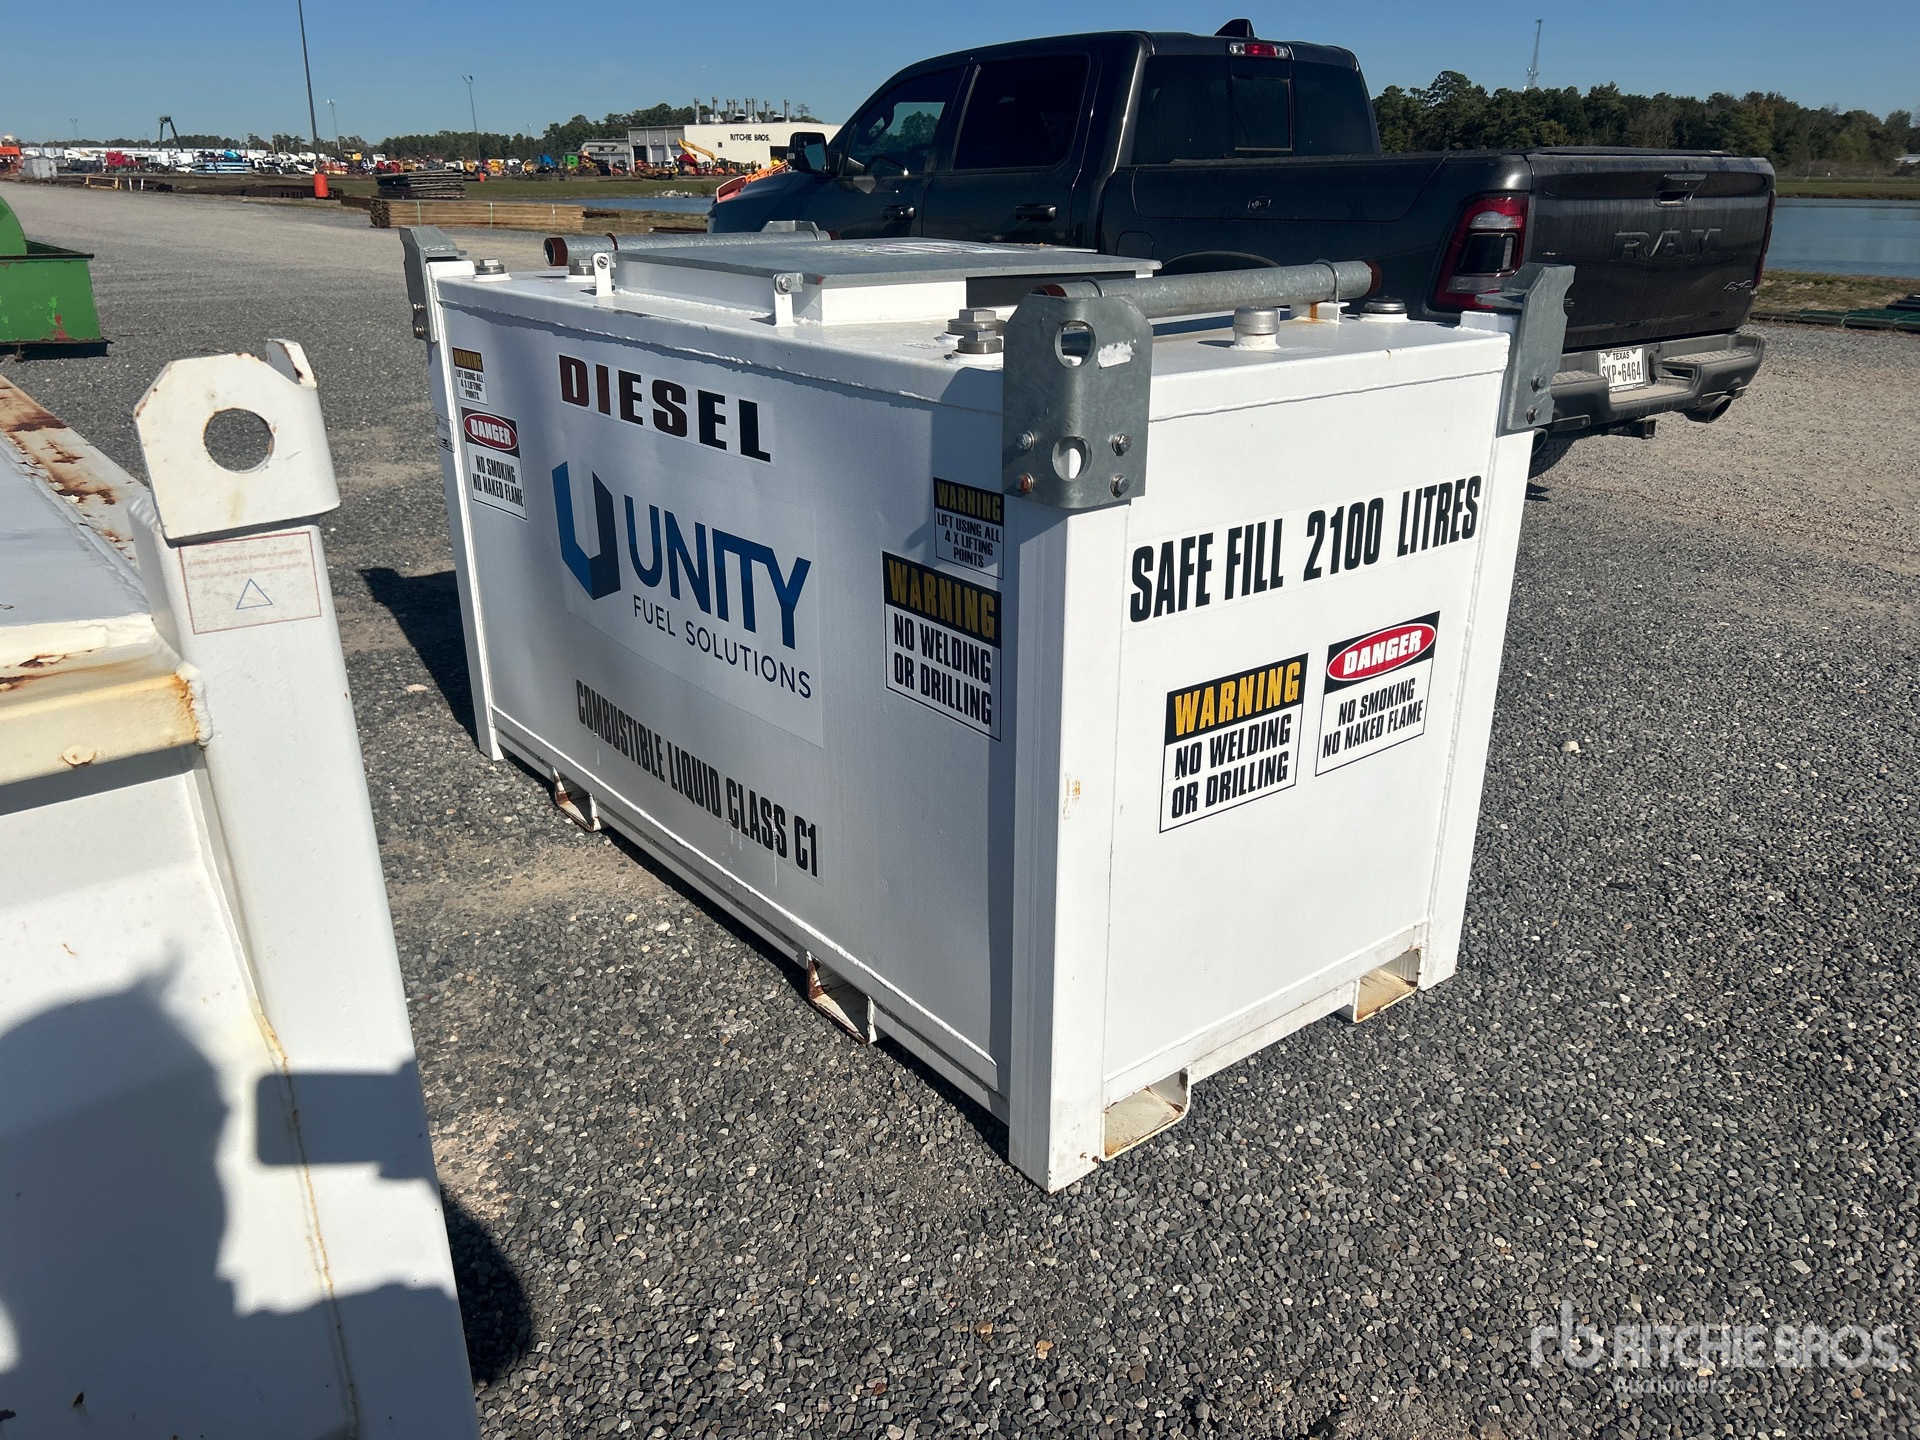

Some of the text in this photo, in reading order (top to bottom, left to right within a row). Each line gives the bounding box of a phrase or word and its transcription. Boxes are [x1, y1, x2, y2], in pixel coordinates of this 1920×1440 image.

[730, 133, 752, 141] RITCHIE
[1609, 228, 1722, 262] RAM
[454, 349, 482, 370] WARNING
[1612, 351, 1630, 361] TEXAS
[465, 389, 480, 400] POINTS
[468, 381, 482, 392] LIFTING
[476, 373, 484, 383] ALL
[559, 354, 771, 462] DIESEL
[470, 418, 512, 446] DANGER
[472, 473, 524, 507] NO NAKED FLAME
[475, 455, 516, 484] NO SMOKING
[936, 482, 1001, 522] WARNING
[937, 512, 1001, 543] LIFT USING ALL
[944, 530, 993, 556] 4 X LIFTING
[1129, 475, 1482, 623] SAFE FILL 2100 LITRES
[624, 494, 811, 650] UNITY
[953, 546, 984, 568] POINTS
[633, 594, 676, 637] FUEL
[888, 559, 995, 640] WARNING
[685, 620, 811, 699] SOLUTIONS
[893, 612, 991, 686] NO WELDING
[1342, 629, 1422, 676] DANGER
[894, 651, 992, 728] OR DRILLING
[1174, 661, 1301, 737] WARNING
[1337, 677, 1416, 727] NO SMOKING
[1175, 713, 1292, 781] NO WELDING
[1322, 699, 1424, 759] NO NAKED FLAME
[576, 679, 818, 877] COMBUSTIBLE LIQUID CLASS C1
[1171, 750, 1289, 819] OR DRILLING
